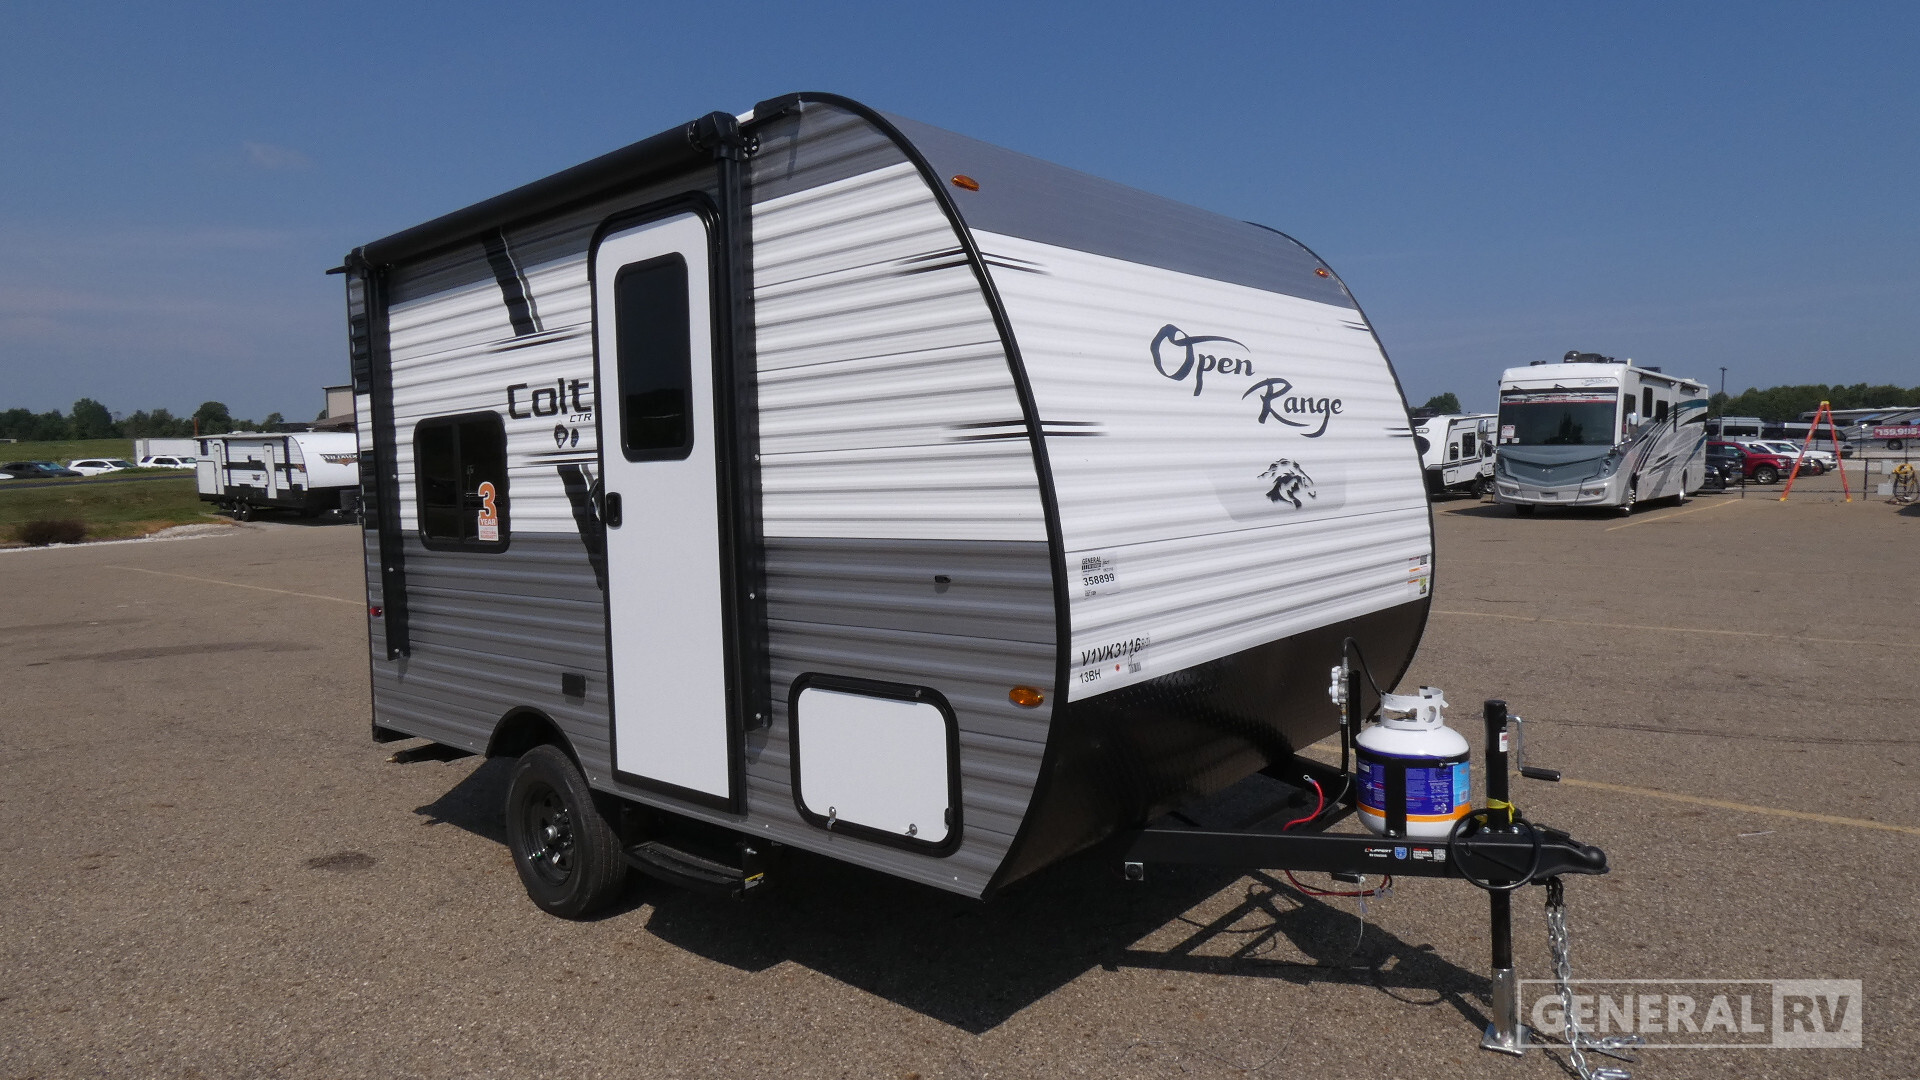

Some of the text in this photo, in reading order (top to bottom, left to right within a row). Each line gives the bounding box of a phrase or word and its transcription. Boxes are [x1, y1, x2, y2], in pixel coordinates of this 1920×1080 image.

[1150, 323, 1255, 396] Open
[506, 377, 592, 419] Colt
[1241, 377, 1343, 438] Range
[569, 413, 592, 423] CTR
[478, 481, 497, 518] 3
[480, 518, 496, 526] YEAR
[1082, 556, 1102, 565] GENERAL
[1083, 573, 1115, 586] 358899
[1081, 637, 1141, 666] V1VK3116
[1080, 668, 1101, 684] 13BH
